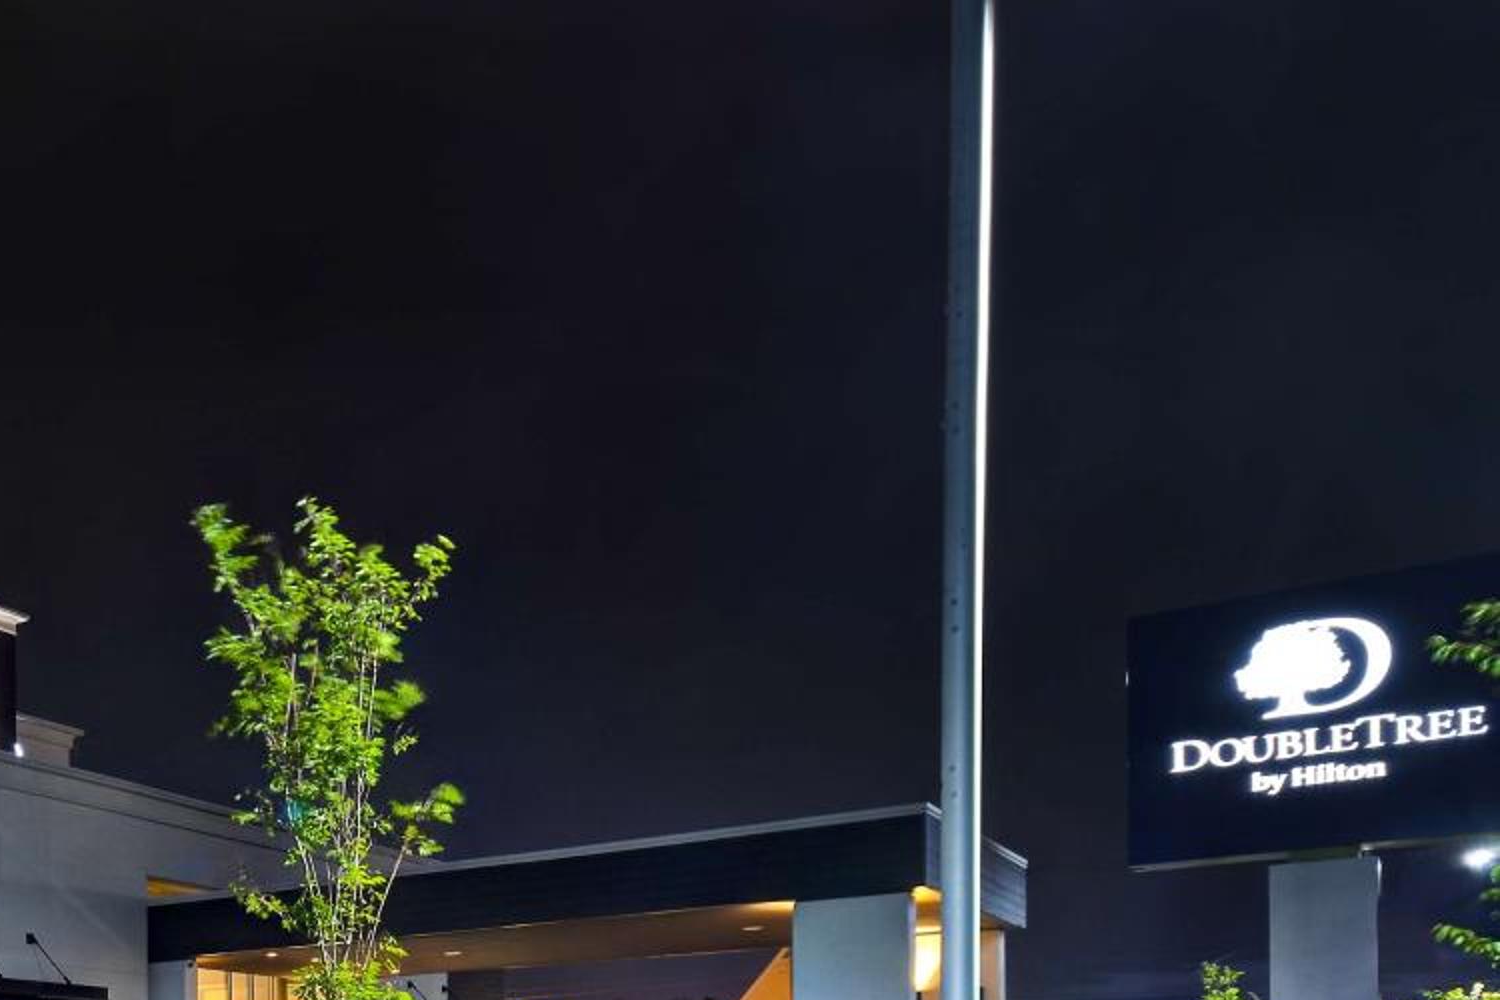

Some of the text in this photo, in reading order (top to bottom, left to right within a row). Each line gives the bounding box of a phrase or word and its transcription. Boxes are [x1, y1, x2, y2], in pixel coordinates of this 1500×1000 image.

[1169, 705, 1489, 774] DOUBLETREE
[1250, 760, 1388, 796] by Hilton
